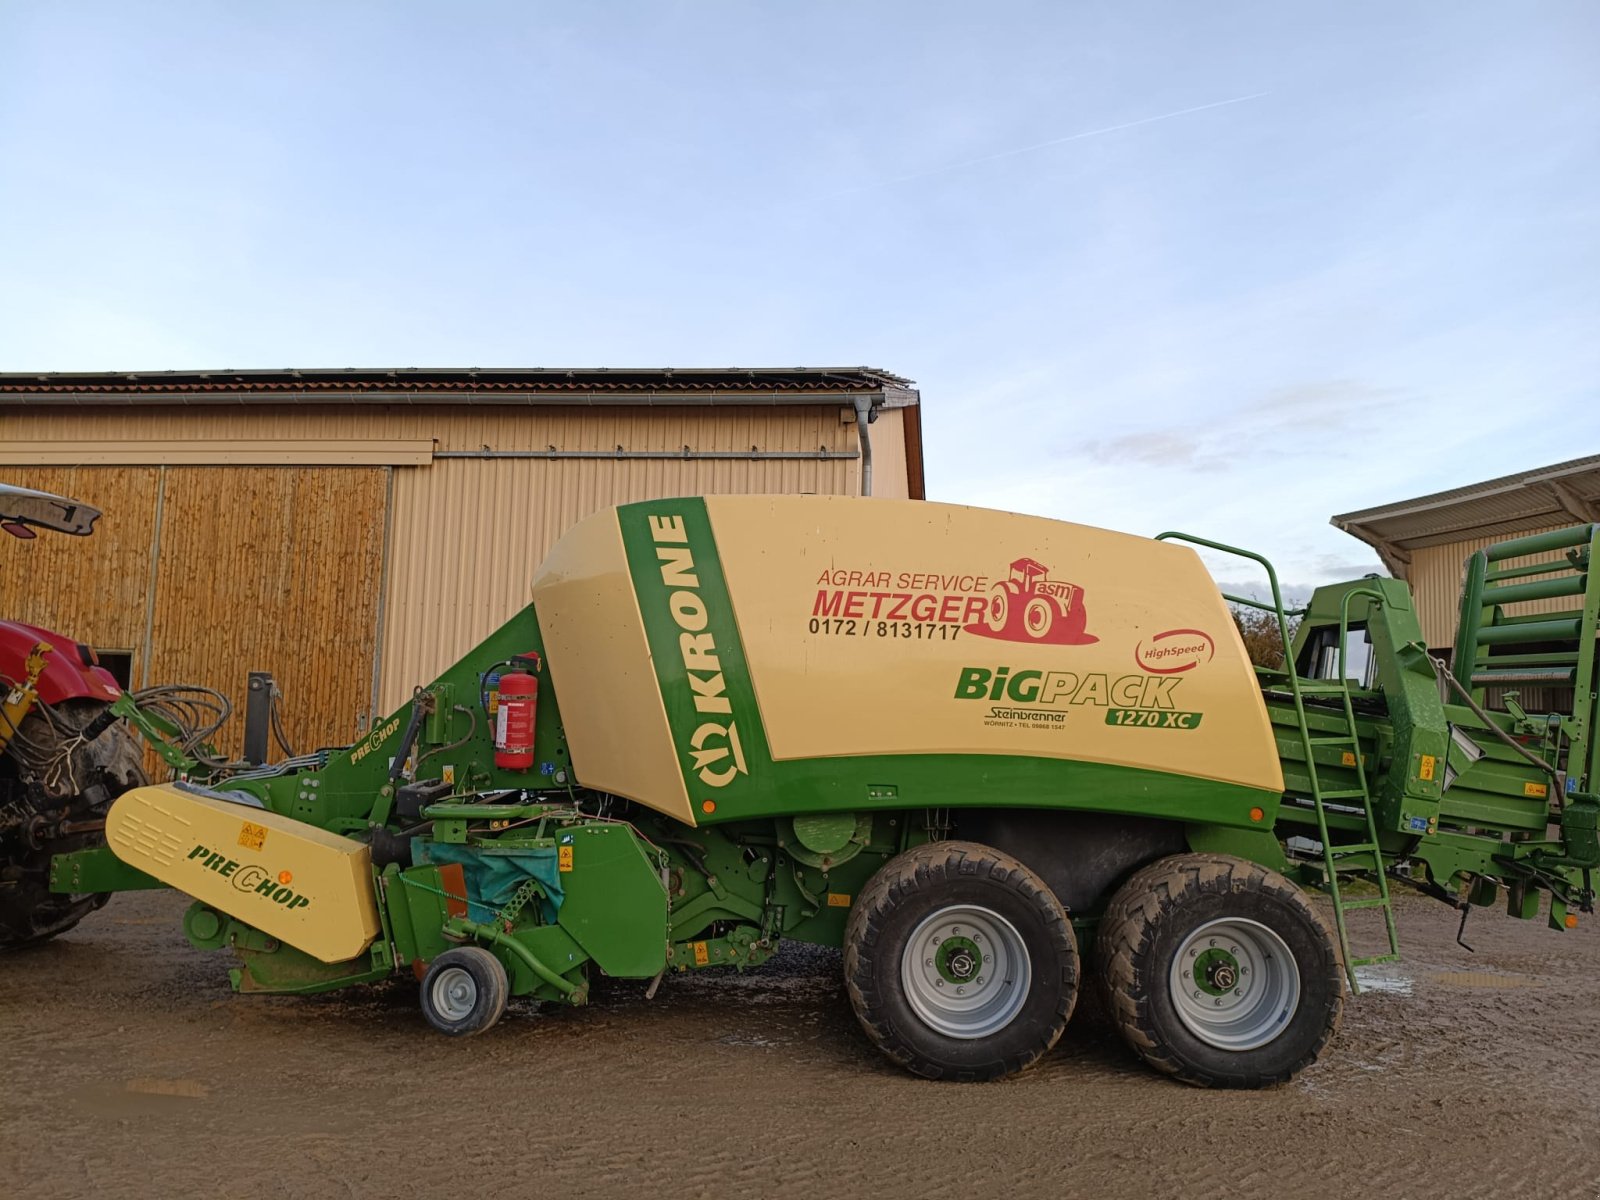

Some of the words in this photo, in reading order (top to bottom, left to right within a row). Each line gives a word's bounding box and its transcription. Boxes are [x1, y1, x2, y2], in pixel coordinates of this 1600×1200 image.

[817, 570, 891, 588] AGRAR
[897, 573, 988, 592] SERVICE
[1037, 583, 1070, 600] asm
[648, 515, 732, 714] KRONE
[812, 590, 988, 624] METZGER
[809, 618, 856, 636] 0172
[863, 620, 870, 637] /
[876, 621, 961, 640] 8131717
[1144, 643, 1205, 660] HighSpeed
[984, 706, 1068, 722] Steinbrenner
[1115, 710, 1159, 727] 1270
[1163, 713, 1192, 728] XC
[351, 718, 401, 766] PRECHOP
[187, 845, 310, 910] PRECHOP
